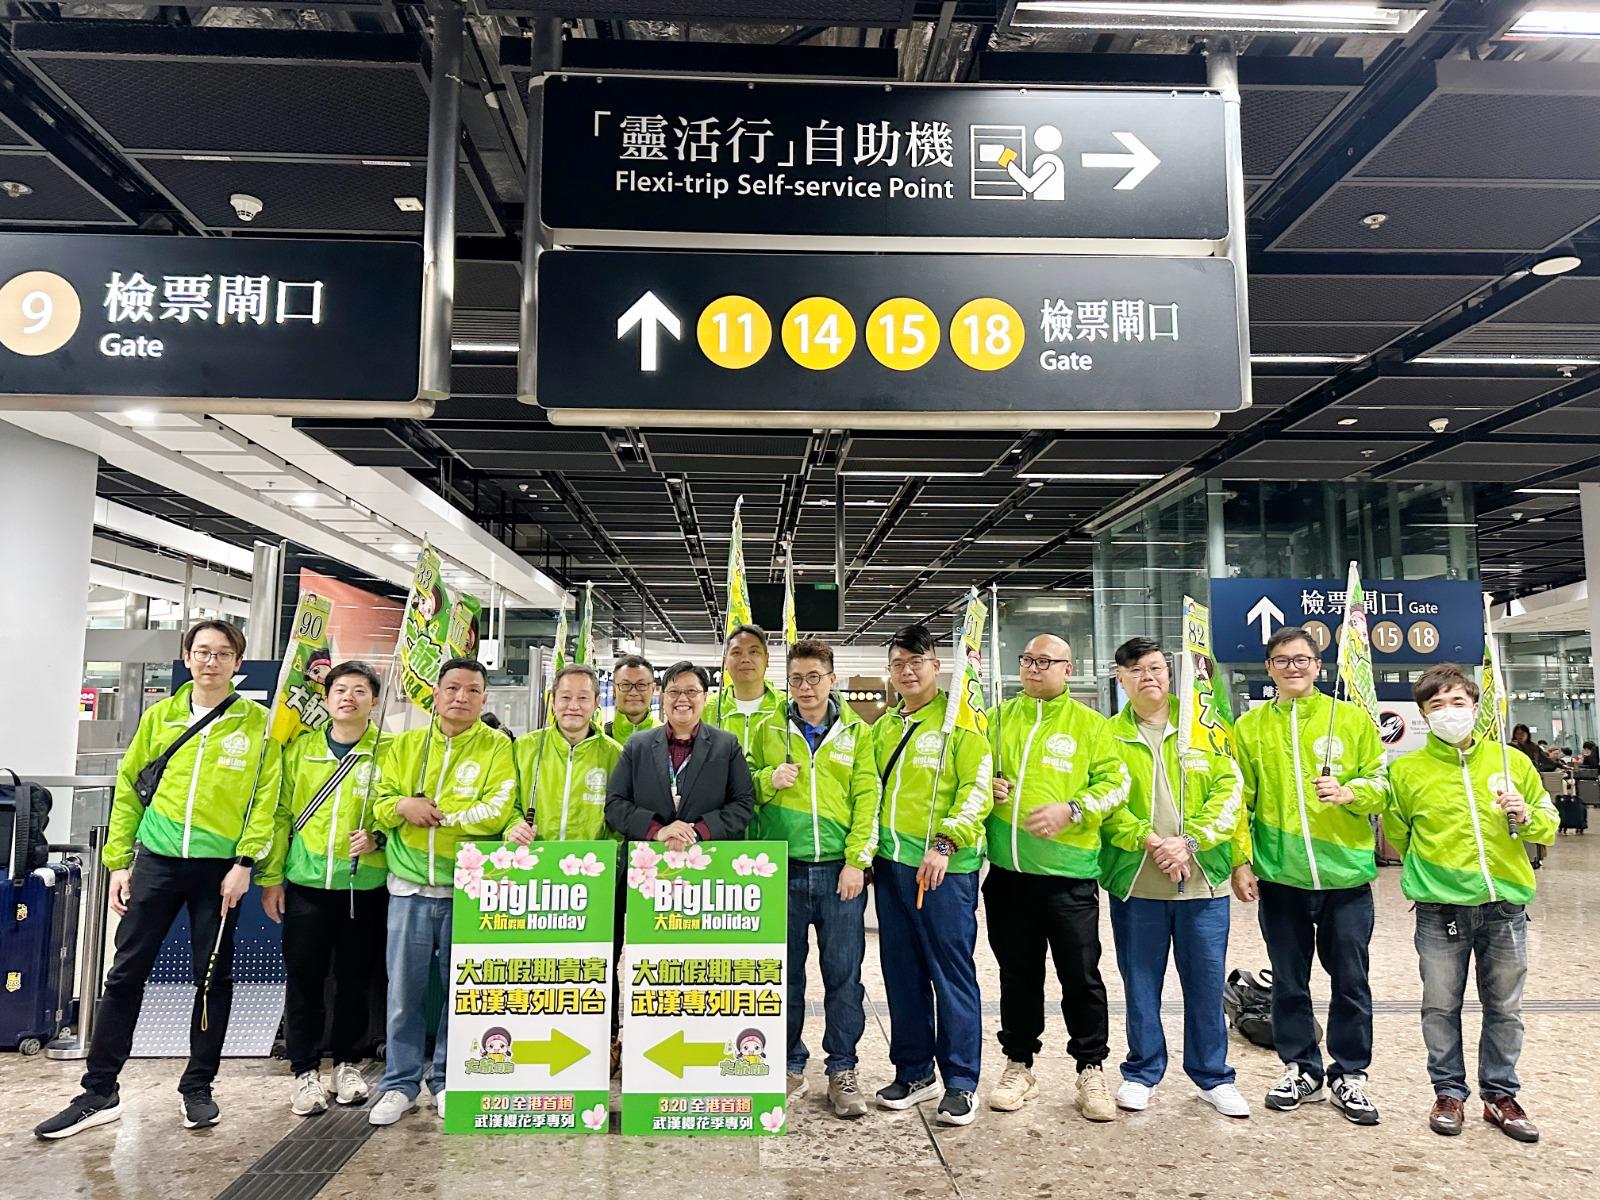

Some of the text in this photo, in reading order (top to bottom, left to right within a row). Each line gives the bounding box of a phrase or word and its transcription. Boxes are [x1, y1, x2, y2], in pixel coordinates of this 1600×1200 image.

[593, 110, 954, 169] 「靈活行」自助機
[615, 169, 954, 200] Flexi-trip Self-service Point
[103, 271, 325, 326] 檢票閘口
[21, 290, 54, 335] 9
[1039, 298, 1180, 345] 檢票閘口
[100, 333, 164, 358] Gate
[712, 313, 1013, 355] 11 14 15 18
[1040, 350, 1093, 372] Gate
[1408, 602, 1439, 614] Gate
[299, 611, 323, 640] 90
[1188, 621, 1206, 647] 82
[1377, 627, 1399, 647] 15
[1413, 627, 1436, 647] 18
[479, 878, 588, 916] BigLine
[654, 878, 761, 916] BigLine
[527, 913, 586, 931] Holiday
[701, 913, 760, 932] Holiday
[456, 958, 608, 985] 大航假期貴賓
[632, 958, 783, 986] 大航假期貴賓
[455, 988, 606, 1016] 武漢專列月台
[631, 989, 783, 1016] 武漢專列月台
[482, 1095, 510, 1111] 3.20
[660, 1098, 688, 1113] 3.20
